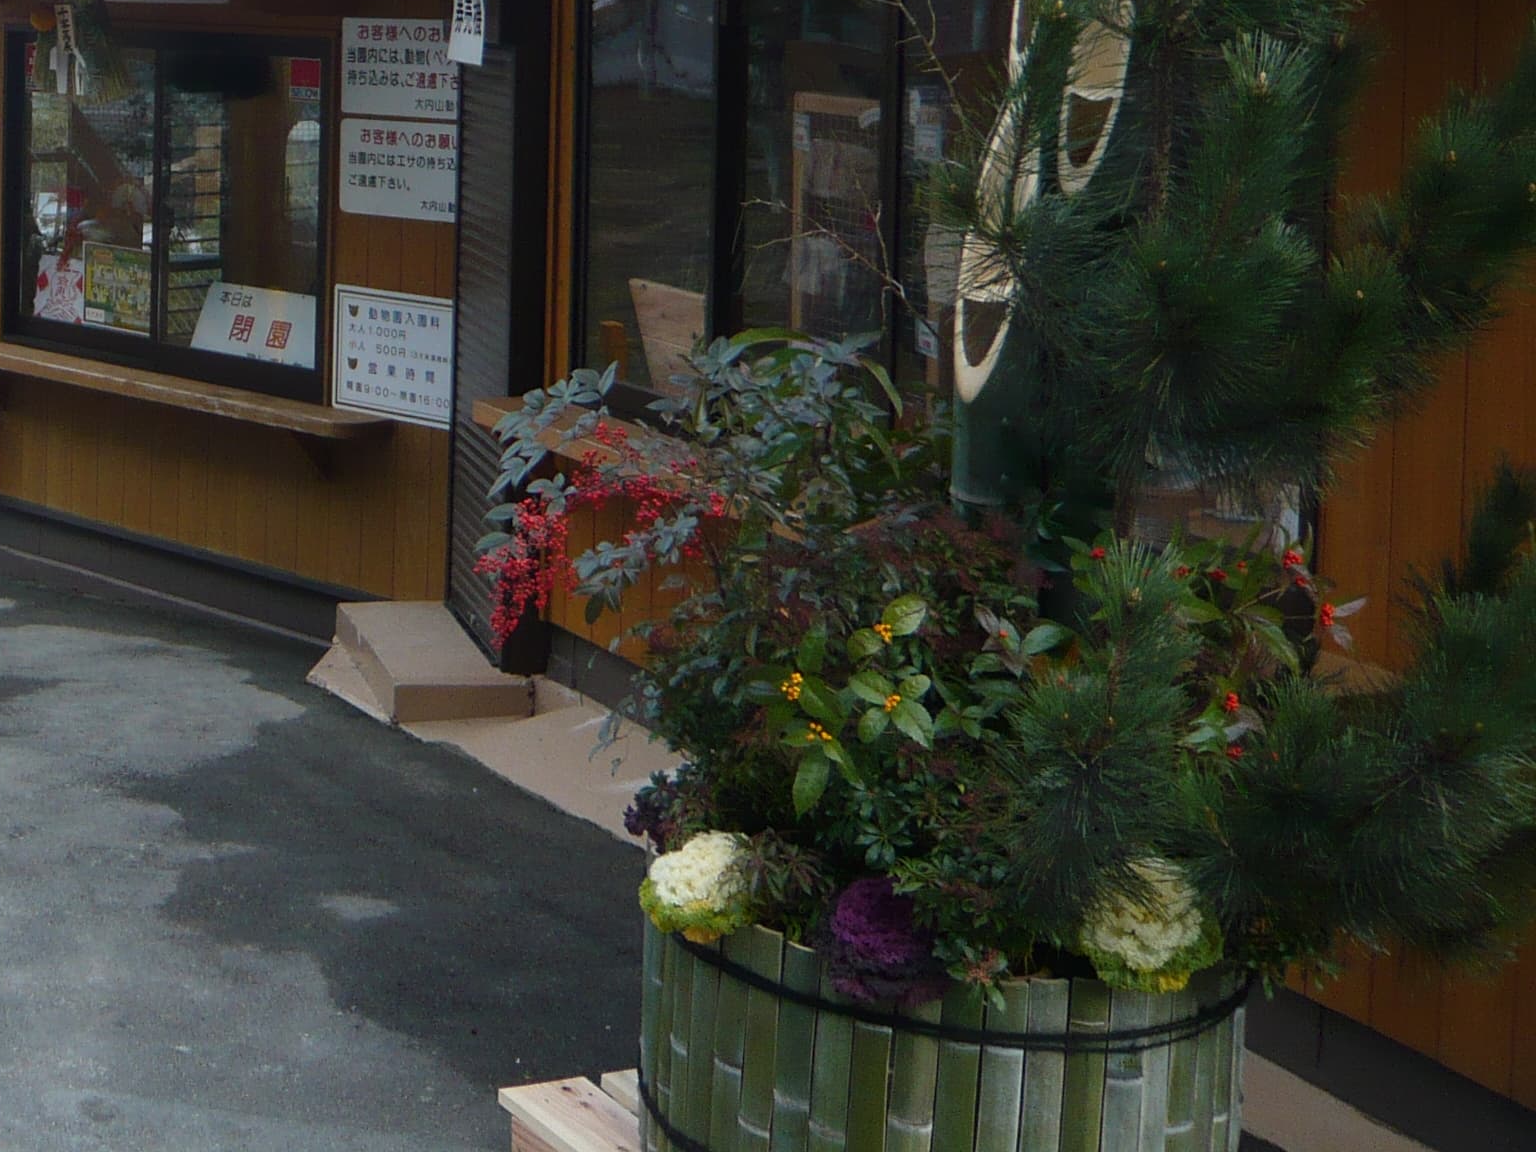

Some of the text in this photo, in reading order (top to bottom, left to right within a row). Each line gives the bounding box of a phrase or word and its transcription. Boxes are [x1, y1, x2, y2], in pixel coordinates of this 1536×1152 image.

[358, 24, 449, 43] お客様へのお
[219, 290, 254, 308] 本日は
[228, 313, 293, 349] 閉園
